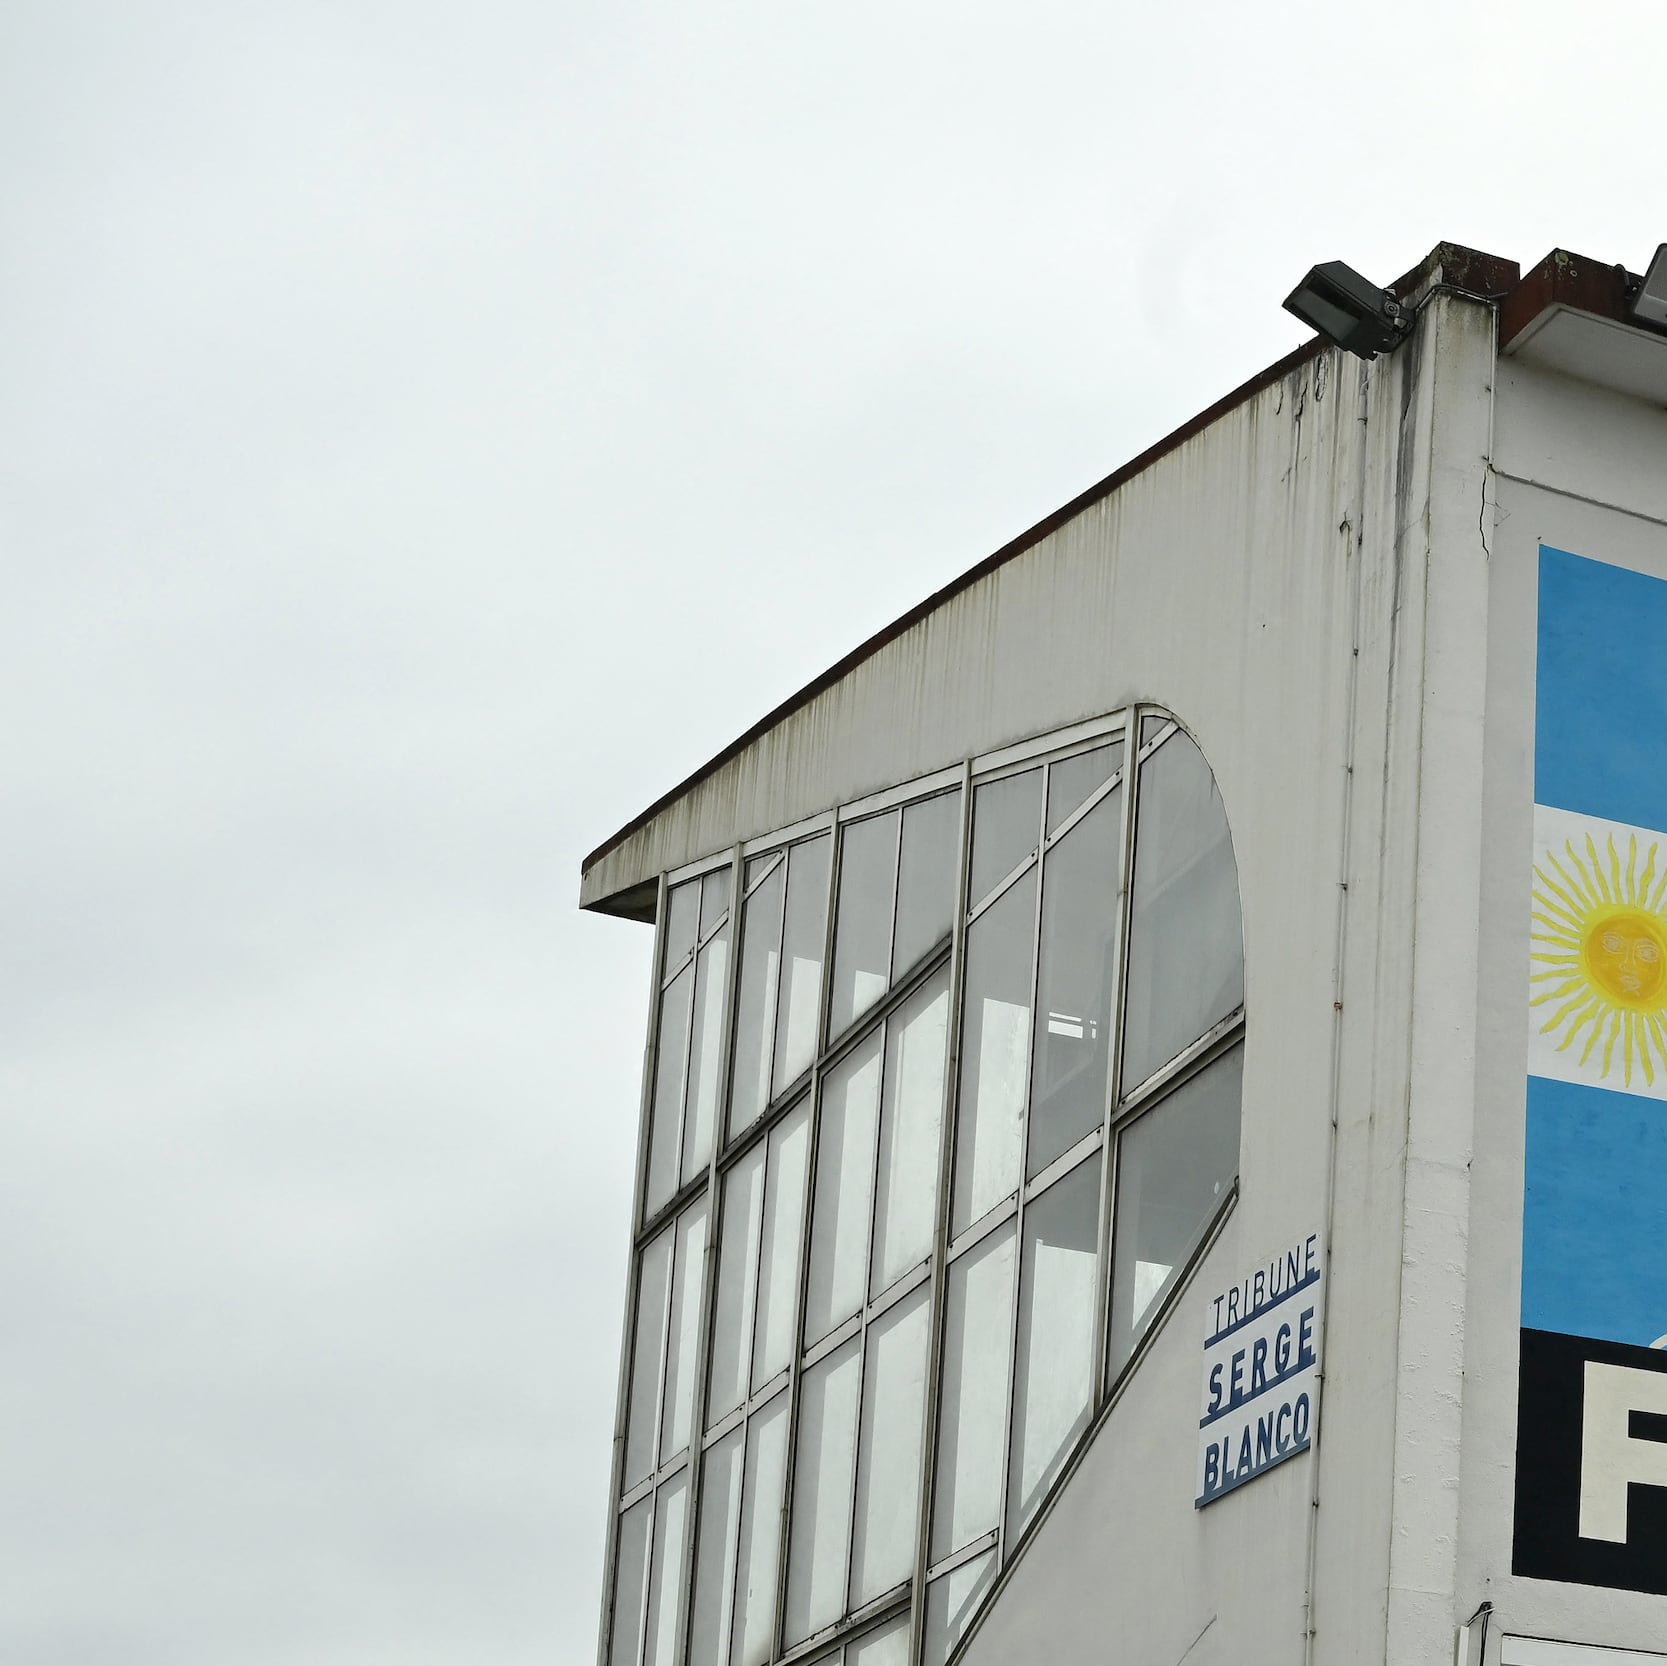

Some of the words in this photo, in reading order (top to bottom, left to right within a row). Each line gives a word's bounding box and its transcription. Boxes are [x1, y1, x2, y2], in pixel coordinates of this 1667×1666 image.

[1213, 1233, 1318, 1335] TRIBUNE
[1207, 1307, 1315, 1416] SERGE
[1203, 1391, 1310, 1496] BLANCO
